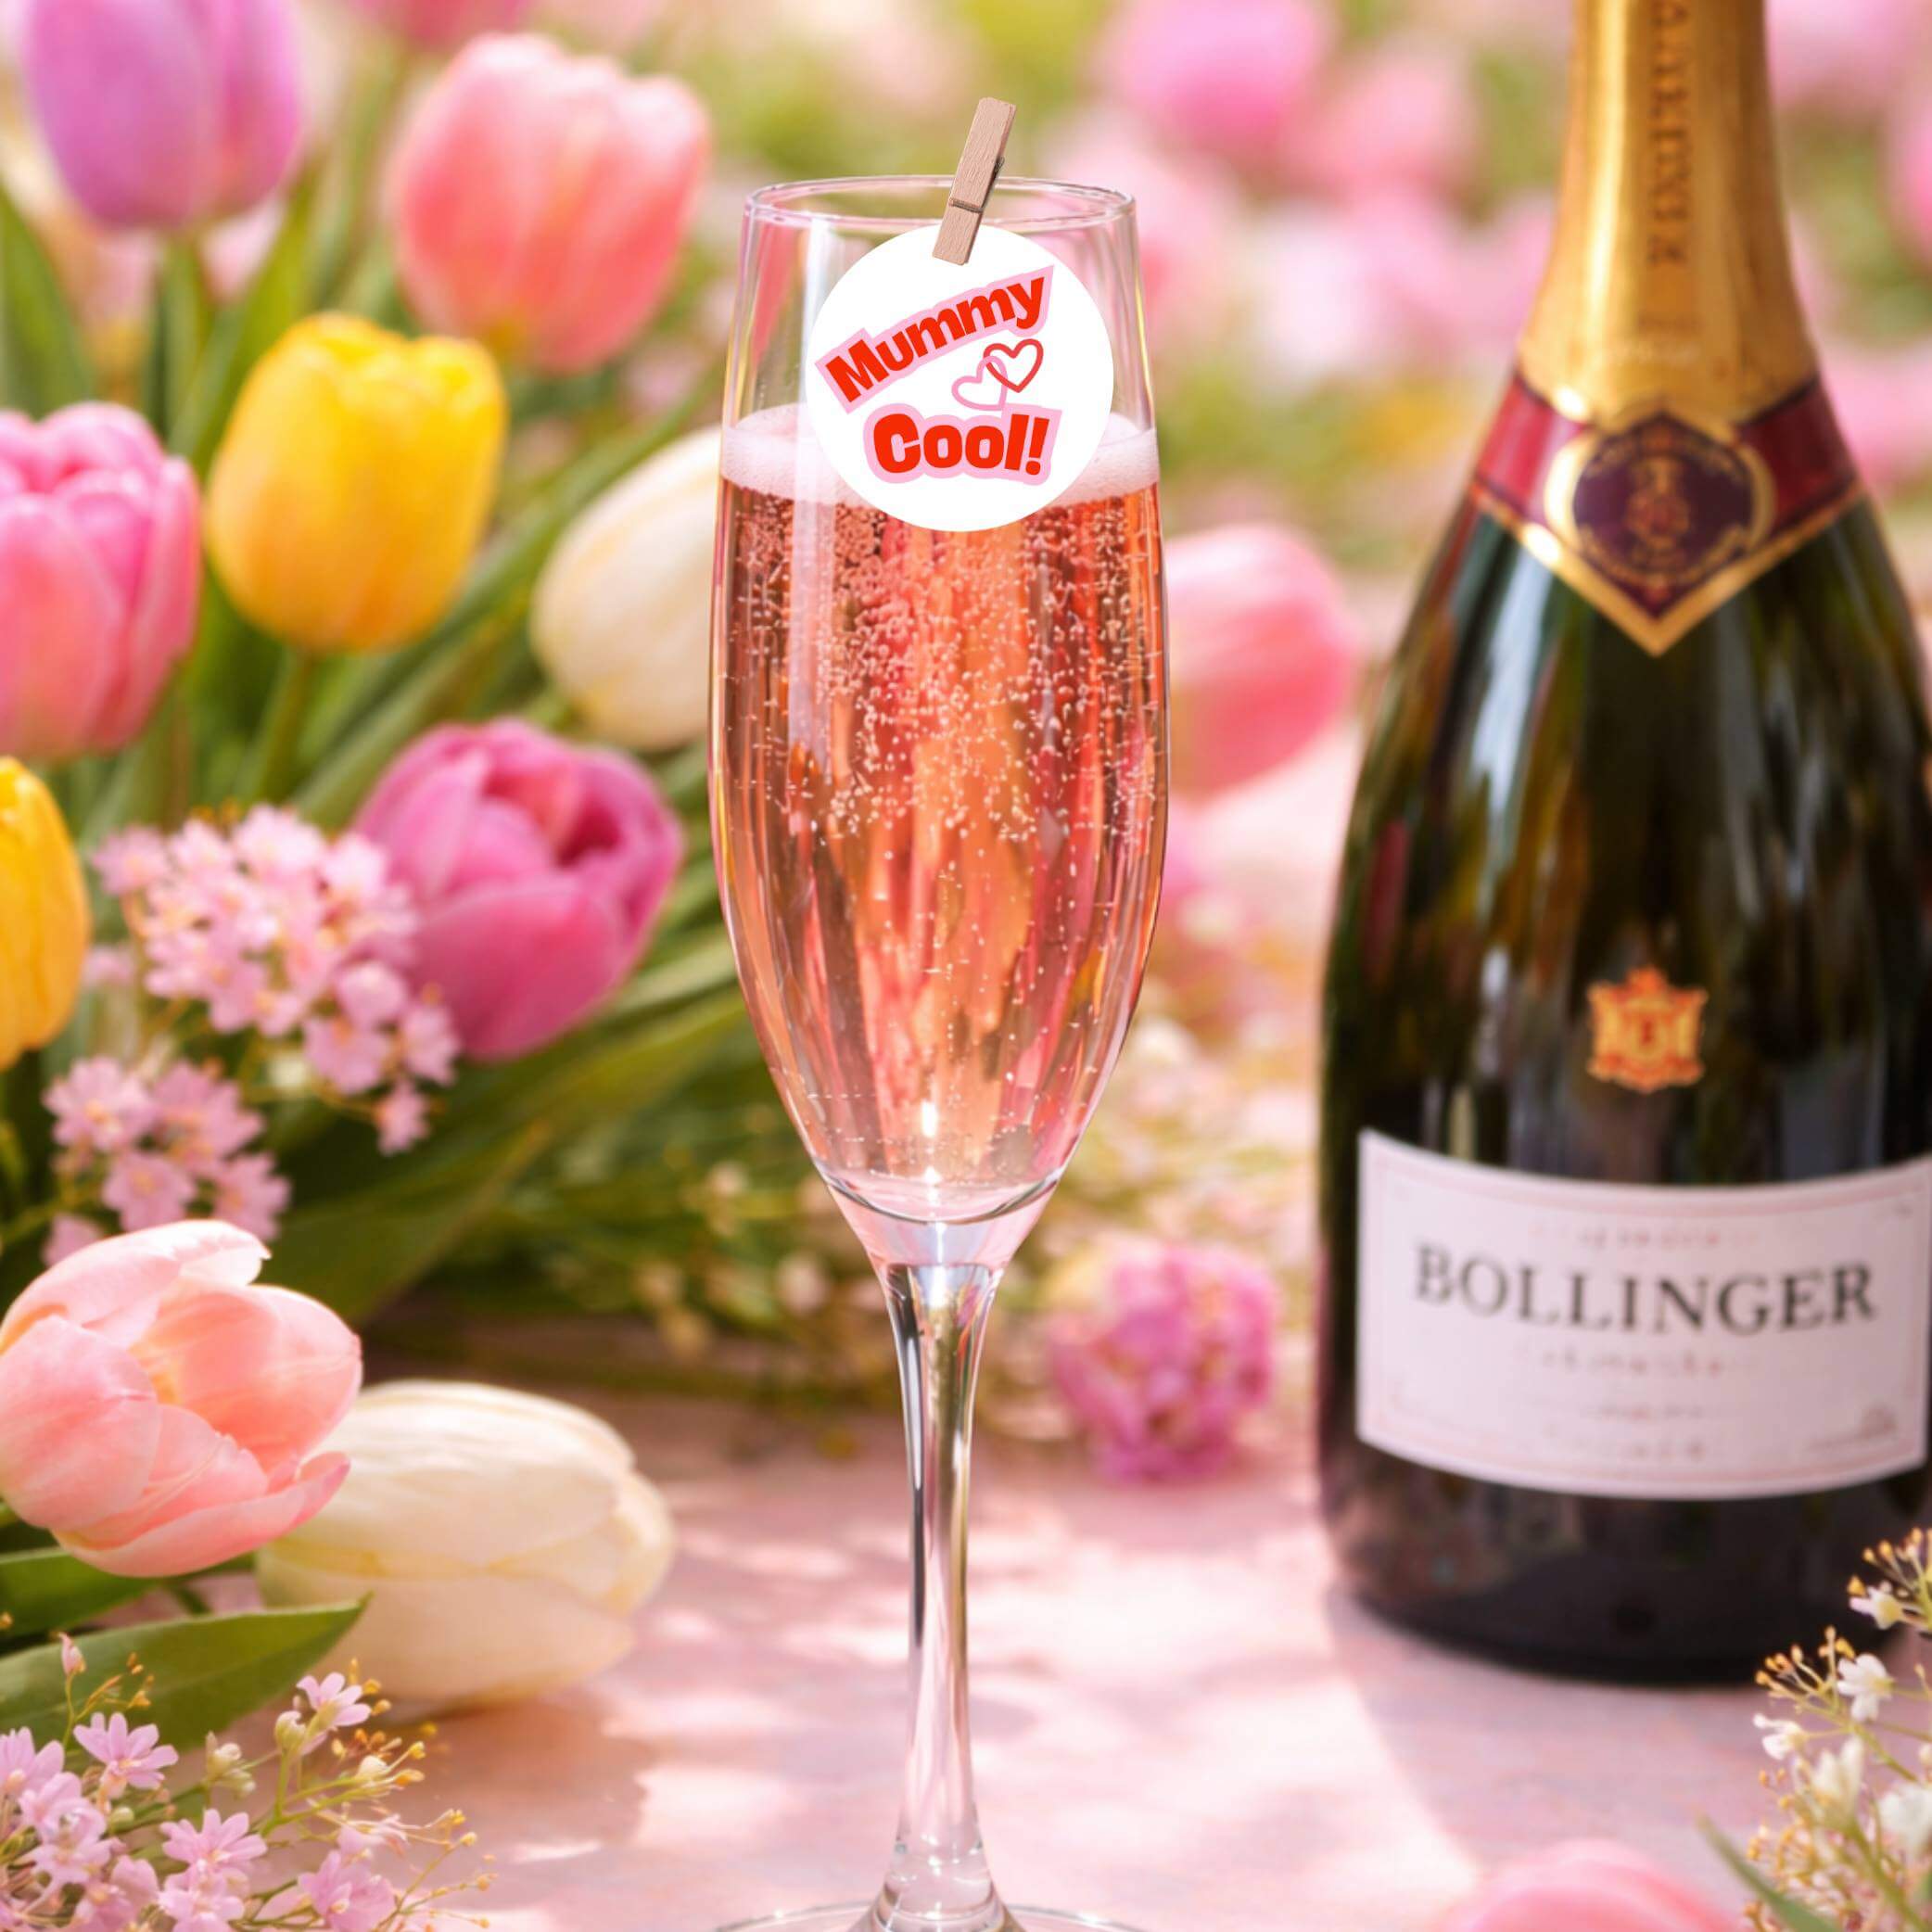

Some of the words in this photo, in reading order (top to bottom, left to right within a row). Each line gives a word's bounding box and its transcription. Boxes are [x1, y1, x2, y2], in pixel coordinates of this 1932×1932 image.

[826, 278, 1044, 402] Mummy
[873, 413, 1049, 476] Cool!
[1415, 1243, 1877, 1335] BOLLINGER
